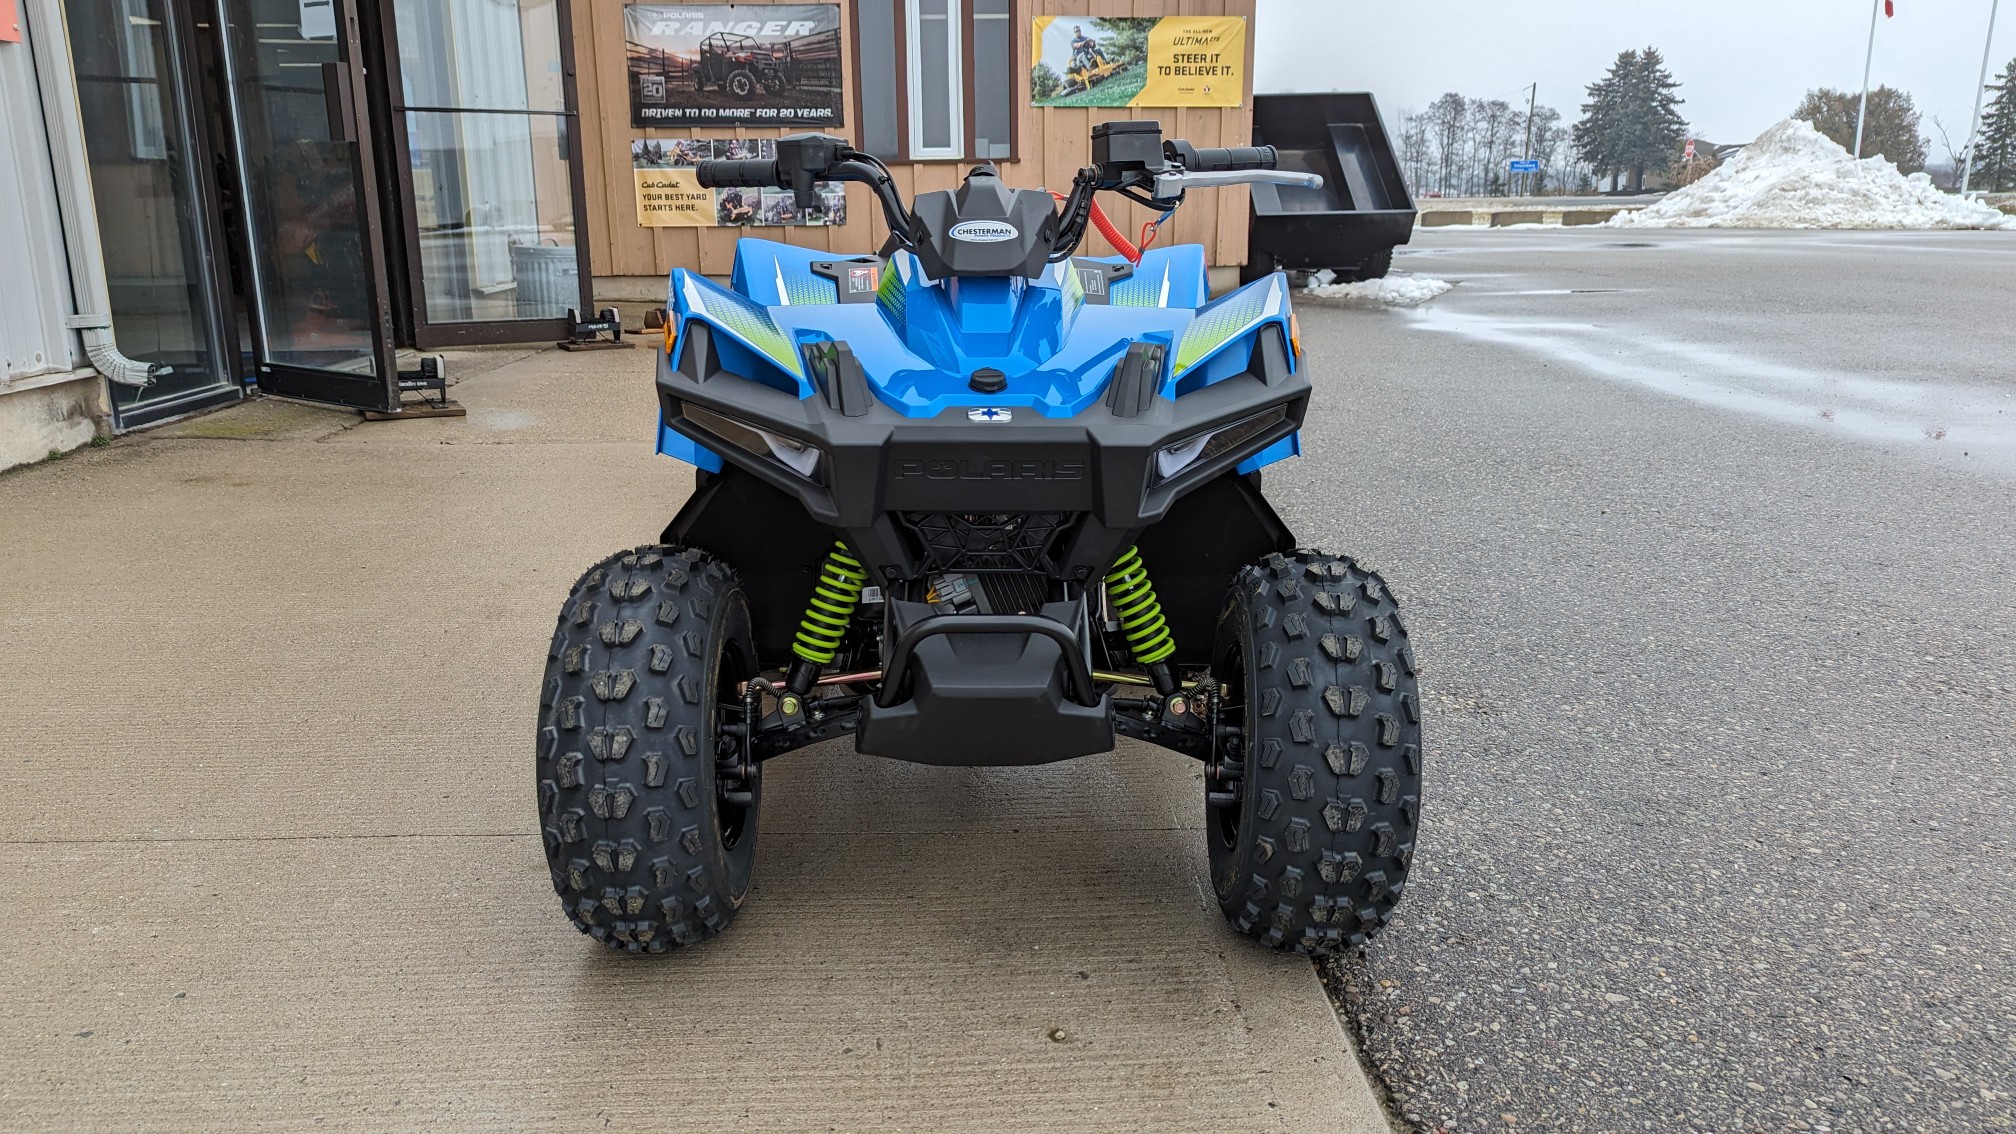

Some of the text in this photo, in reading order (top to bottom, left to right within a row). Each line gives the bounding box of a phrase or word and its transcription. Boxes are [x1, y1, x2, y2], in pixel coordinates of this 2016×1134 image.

[663, 11, 704, 19] POLARIS
[650, 21, 815, 36] RANGER
[1173, 36, 1208, 46] ULTIMA
[1173, 54, 1221, 63] STEER IT
[1158, 66, 1234, 76] TO BELIEVE IT.
[643, 83, 663, 97] 20
[641, 108, 682, 118] DRIVEN
[685, 108, 699, 118] TO
[701, 108, 717, 118] DO
[756, 108, 777, 118] FOR
[780, 108, 795, 118] 20
[797, 108, 834, 118] YEARS.
[642, 193, 707, 201] YOUR BEST YARD
[643, 204, 673, 212] STARTS
[895, 459, 1086, 480] POLARIS
